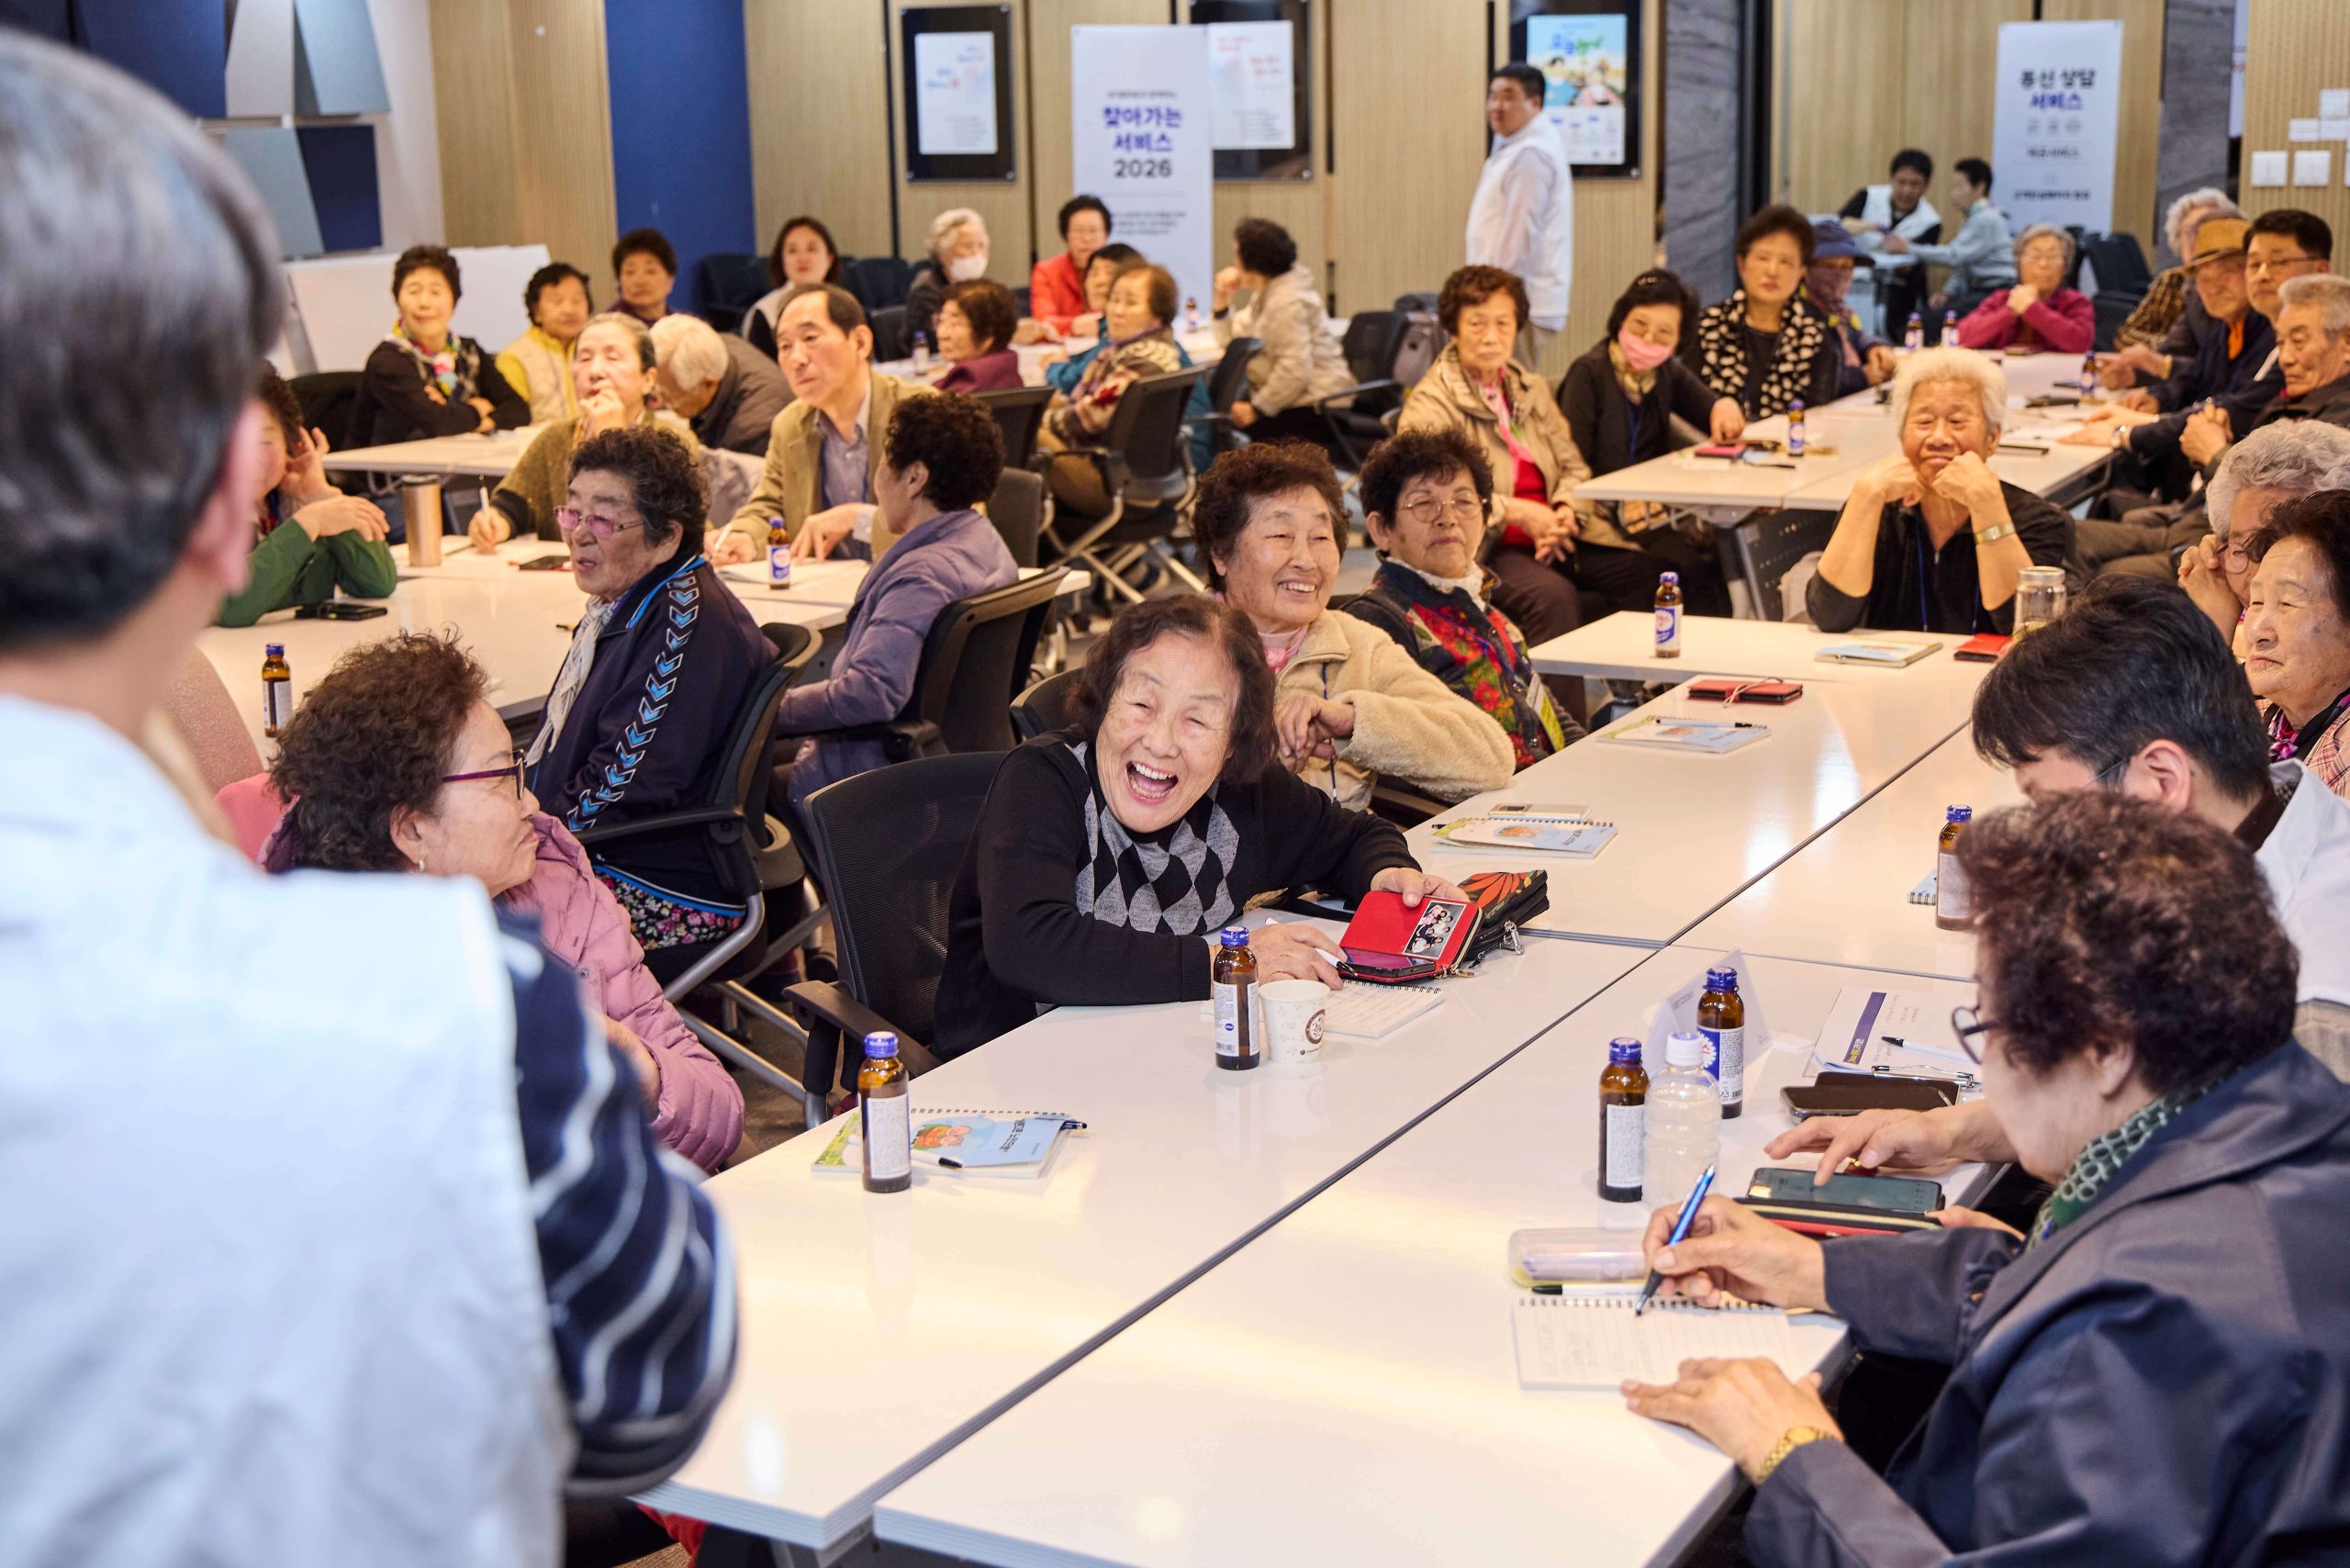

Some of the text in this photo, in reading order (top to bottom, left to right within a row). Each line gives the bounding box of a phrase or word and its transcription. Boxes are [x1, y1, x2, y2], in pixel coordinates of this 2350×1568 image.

[2062, 69, 2096, 89] 상담
[2031, 94, 2083, 110] 서비스
[1104, 106, 1181, 128] 찾아가는
[1114, 133, 1172, 153] 서비스
[1114, 159, 1172, 177] 2026
